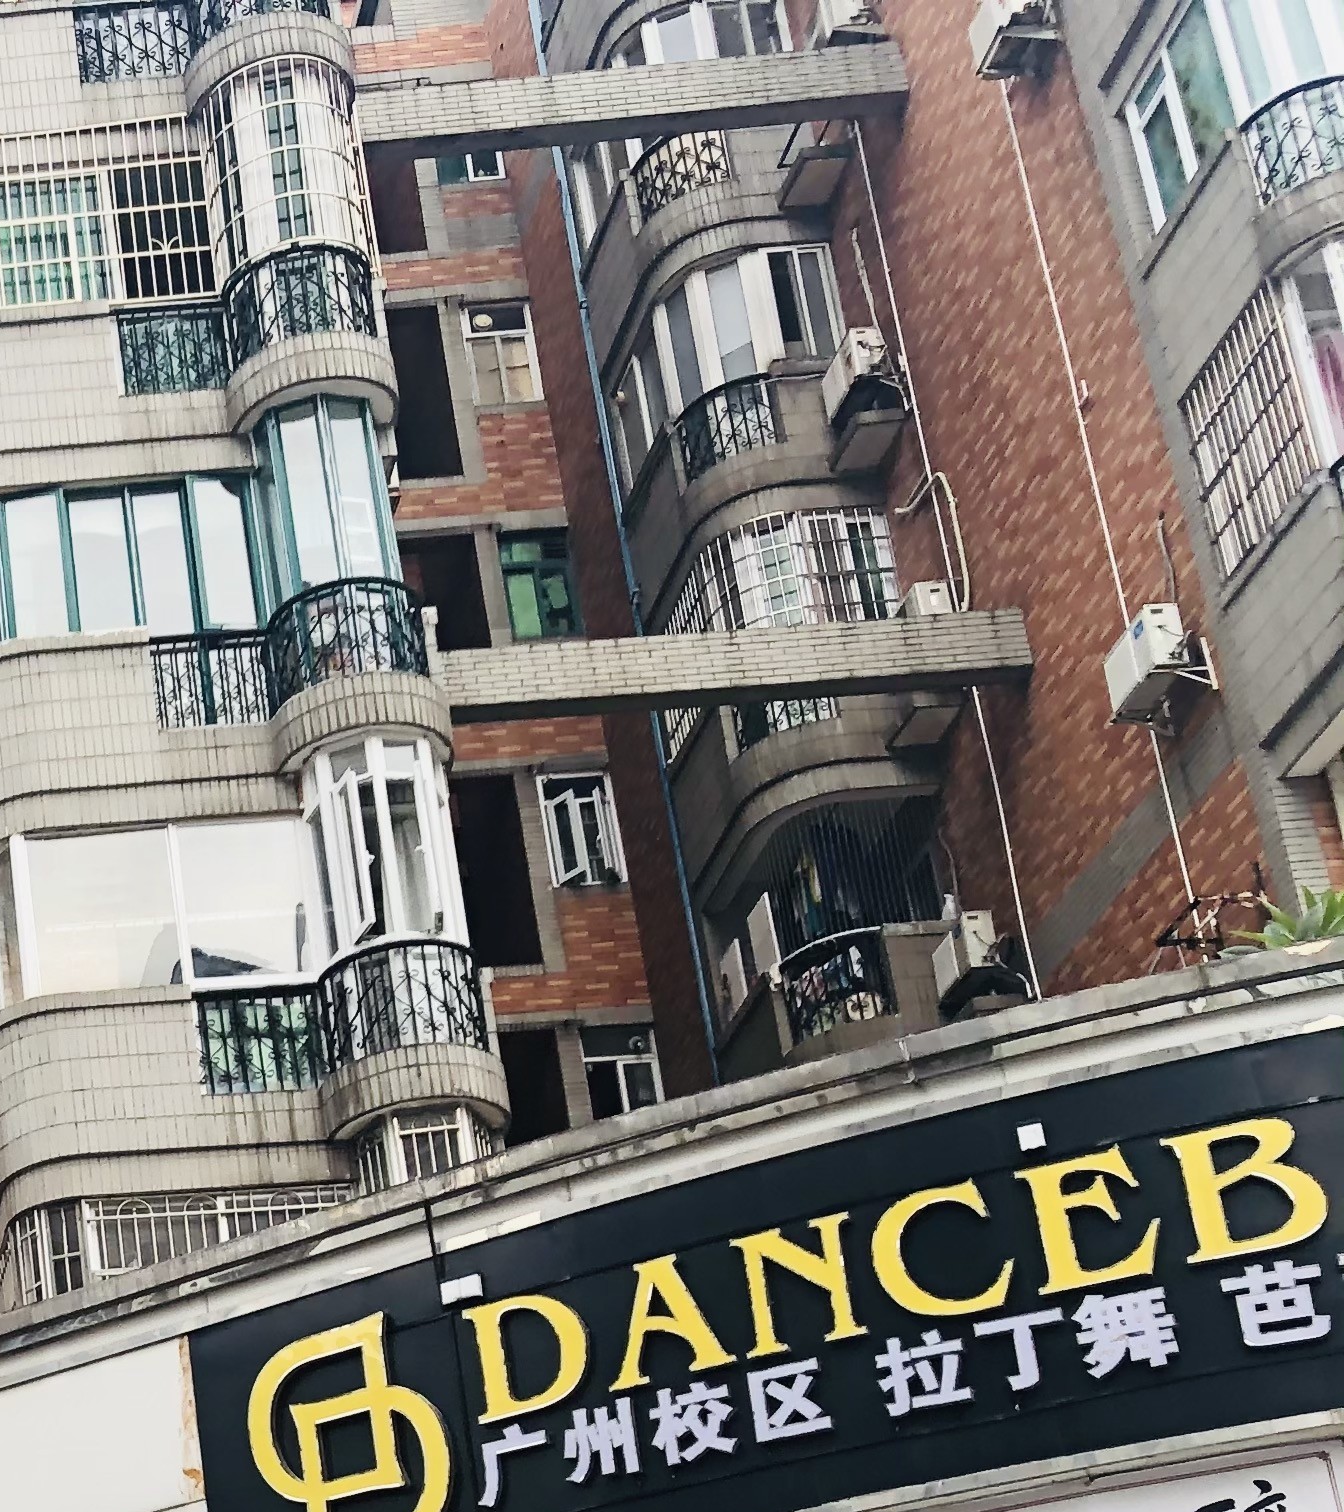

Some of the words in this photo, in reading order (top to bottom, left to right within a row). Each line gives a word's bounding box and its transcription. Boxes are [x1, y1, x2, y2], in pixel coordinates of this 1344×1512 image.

[462, 1116, 1327, 1424] DANCEB
[478, 1357, 831, 1507] 广州校区
[876, 1285, 1180, 1417] 拉丁舞
[1221, 1258, 1344, 1349] 芭
